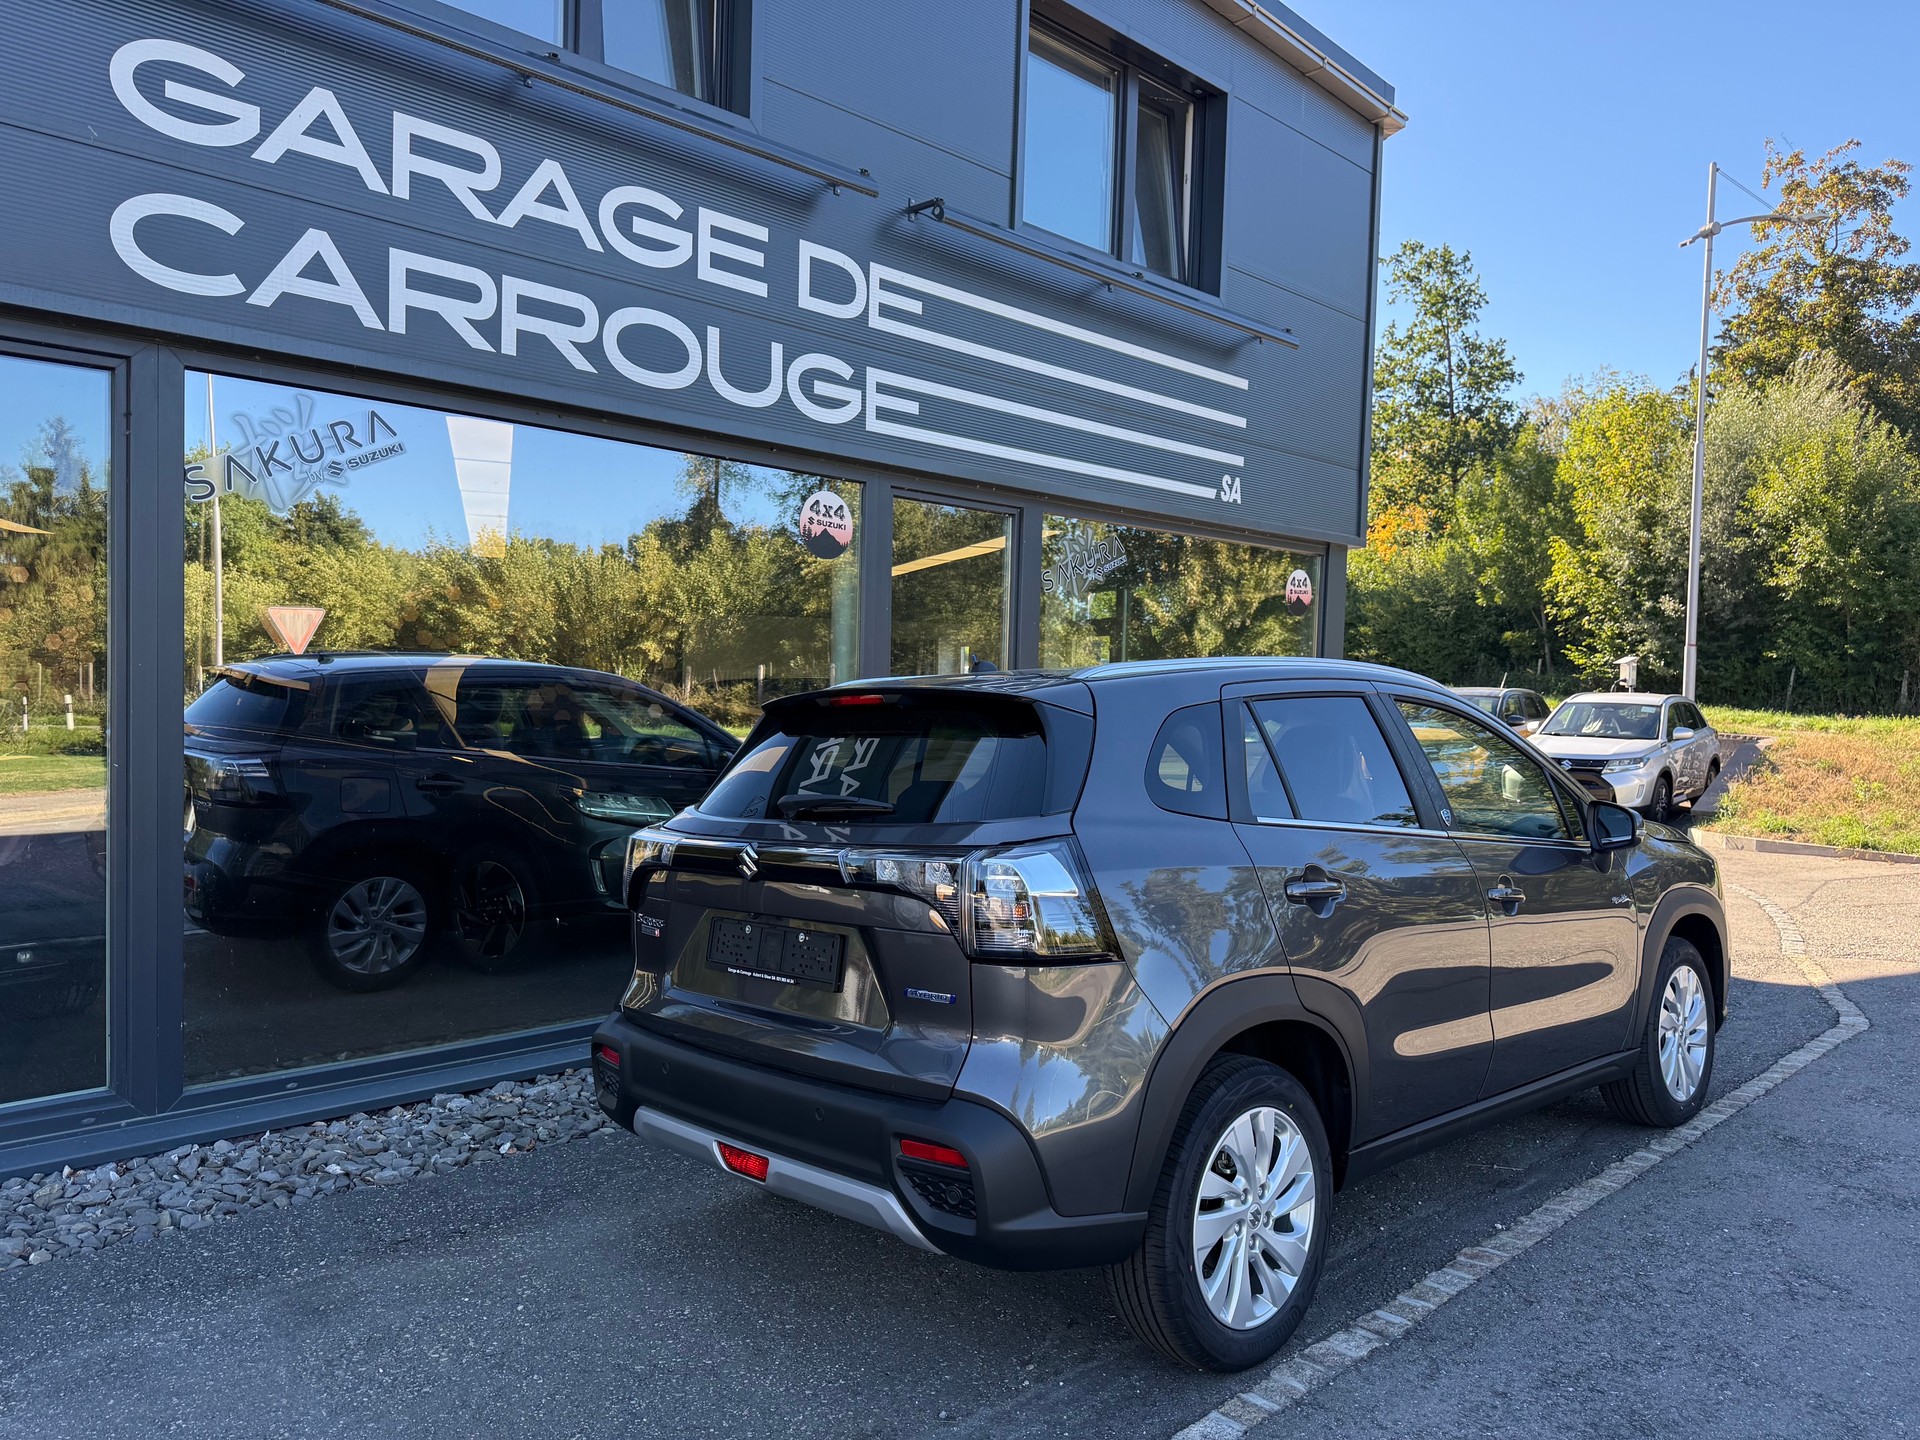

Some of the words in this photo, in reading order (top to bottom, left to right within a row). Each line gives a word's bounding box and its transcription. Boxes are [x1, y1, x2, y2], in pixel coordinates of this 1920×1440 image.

[109, 38, 768, 298] GARAGE
[109, 192, 921, 440] CARROUGE
[184, 409, 398, 501] SAKURA
[346, 442, 406, 470] SUZUKI
[1220, 474, 1242, 504] SA
[809, 499, 845, 521] 4x4
[816, 519, 847, 531] SUZUKI
[1042, 535, 1125, 592] SAKURA
[1290, 576, 1308, 588] 4x4
